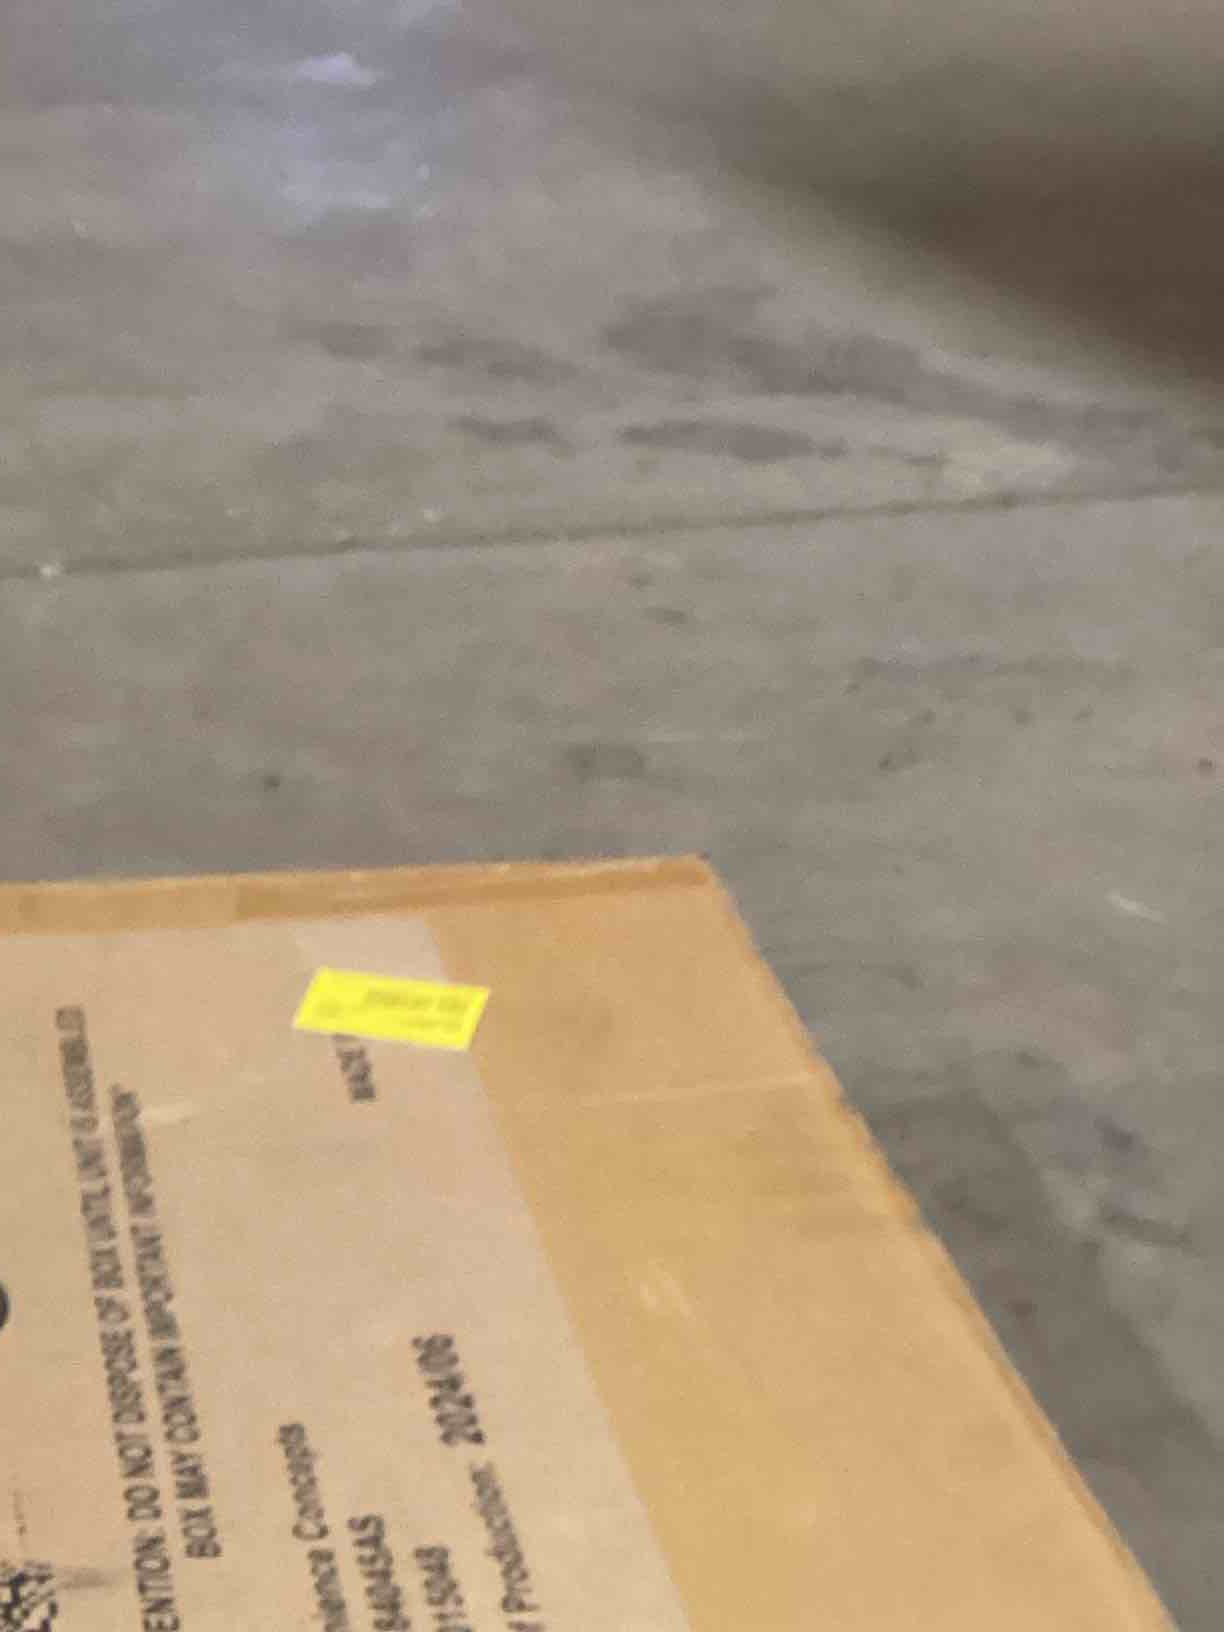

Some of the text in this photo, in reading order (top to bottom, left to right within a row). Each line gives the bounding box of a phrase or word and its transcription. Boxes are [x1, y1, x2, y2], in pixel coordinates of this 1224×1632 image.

[73, 1138, 109, 1179] UNIT
[82, 1183, 116, 1241] UNTIL
[88, 1246, 123, 1289] BOX
[130, 1225, 179, 1341] IMPORTANT
[95, 1295, 129, 1323] OF
[99, 1329, 145, 1423] DISPOSE
[153, 1346, 201, 1443] CONTAIN
[119, 1431, 153, 1478] NOT
[168, 1452, 209, 1500] MAY
[124, 1484, 163, 1522] DO
[275, 1422, 329, 1541] Concepts
[179, 1506, 221, 1559] BOX
